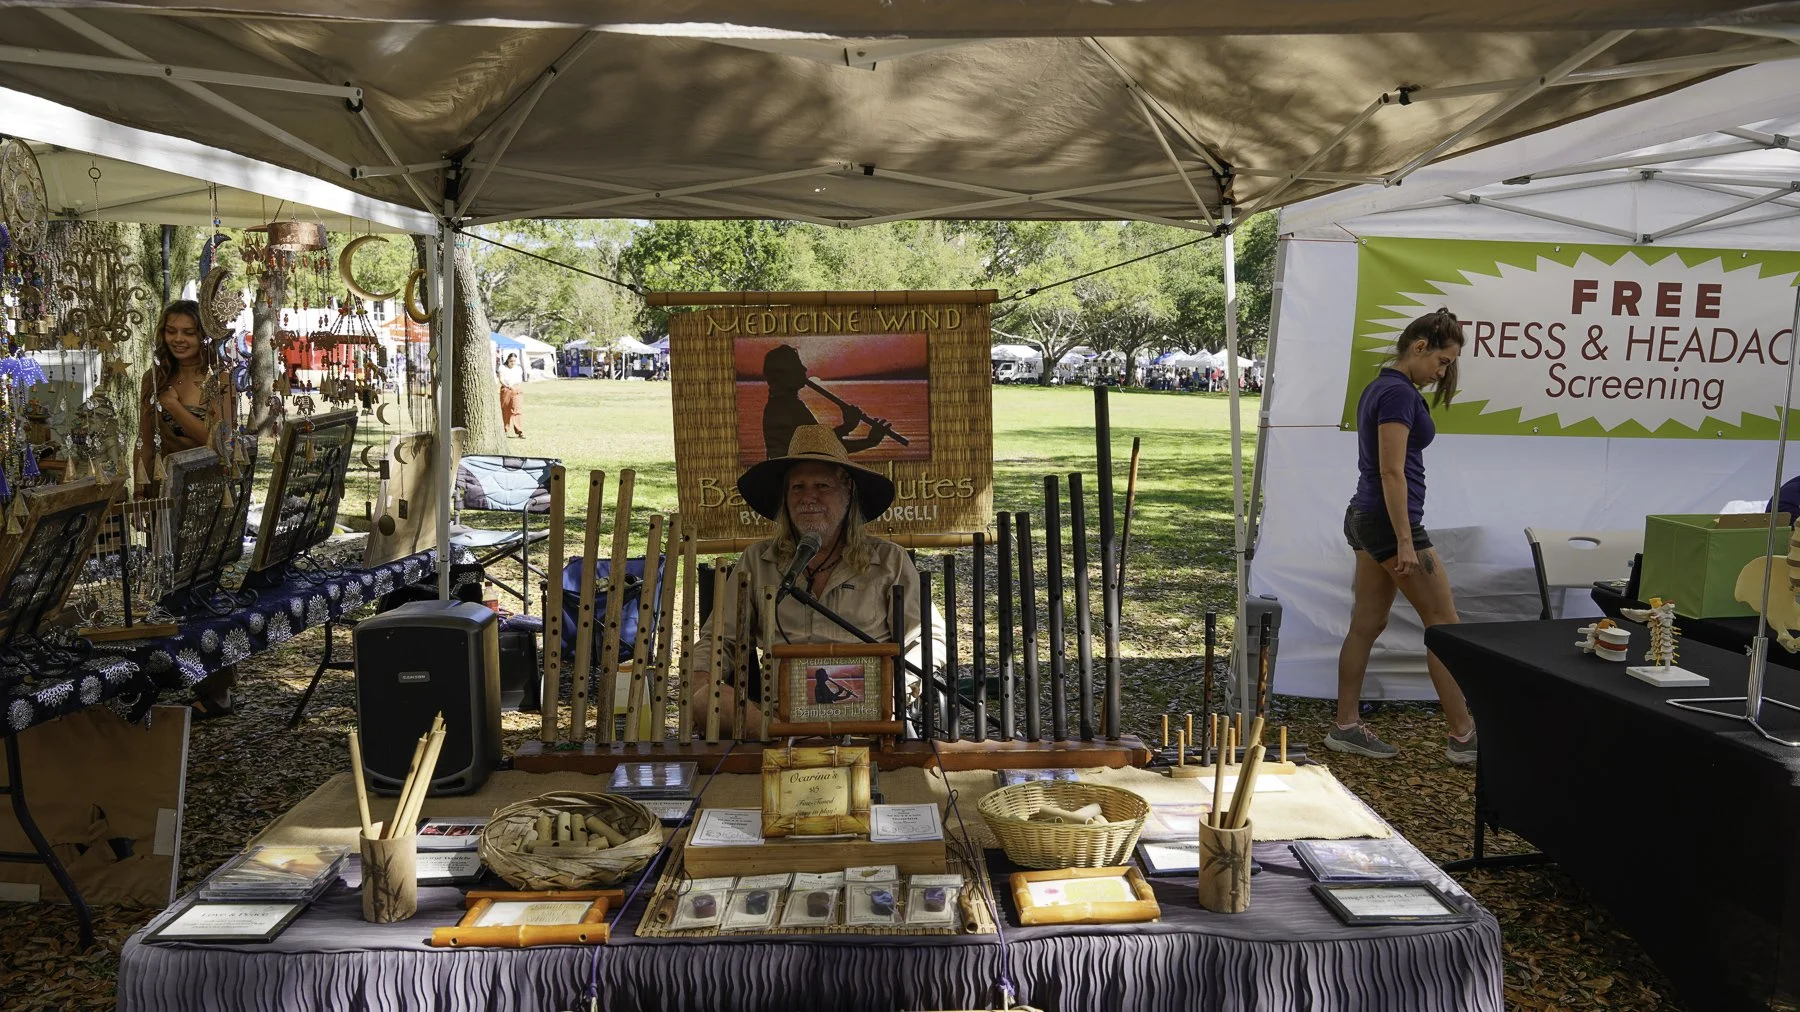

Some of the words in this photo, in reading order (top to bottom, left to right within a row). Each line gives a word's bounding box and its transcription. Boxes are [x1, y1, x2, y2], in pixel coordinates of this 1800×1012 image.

[1571, 279, 1722, 319] FREE
[706, 311, 862, 336] MEDICINE
[876, 308, 963, 331] WIND
[1456, 320, 1567, 360] TRESS
[1581, 324, 1609, 361] &
[1626, 325, 1800, 366] HEADAC
[1545, 362, 1725, 411] Screening
[888, 460, 975, 500] lutes
[877, 505, 938, 522] ORELLI
[795, 703, 841, 718] Bamboo
[844, 702, 878, 716] Flutes
[789, 770, 838, 784] Ocarina's
